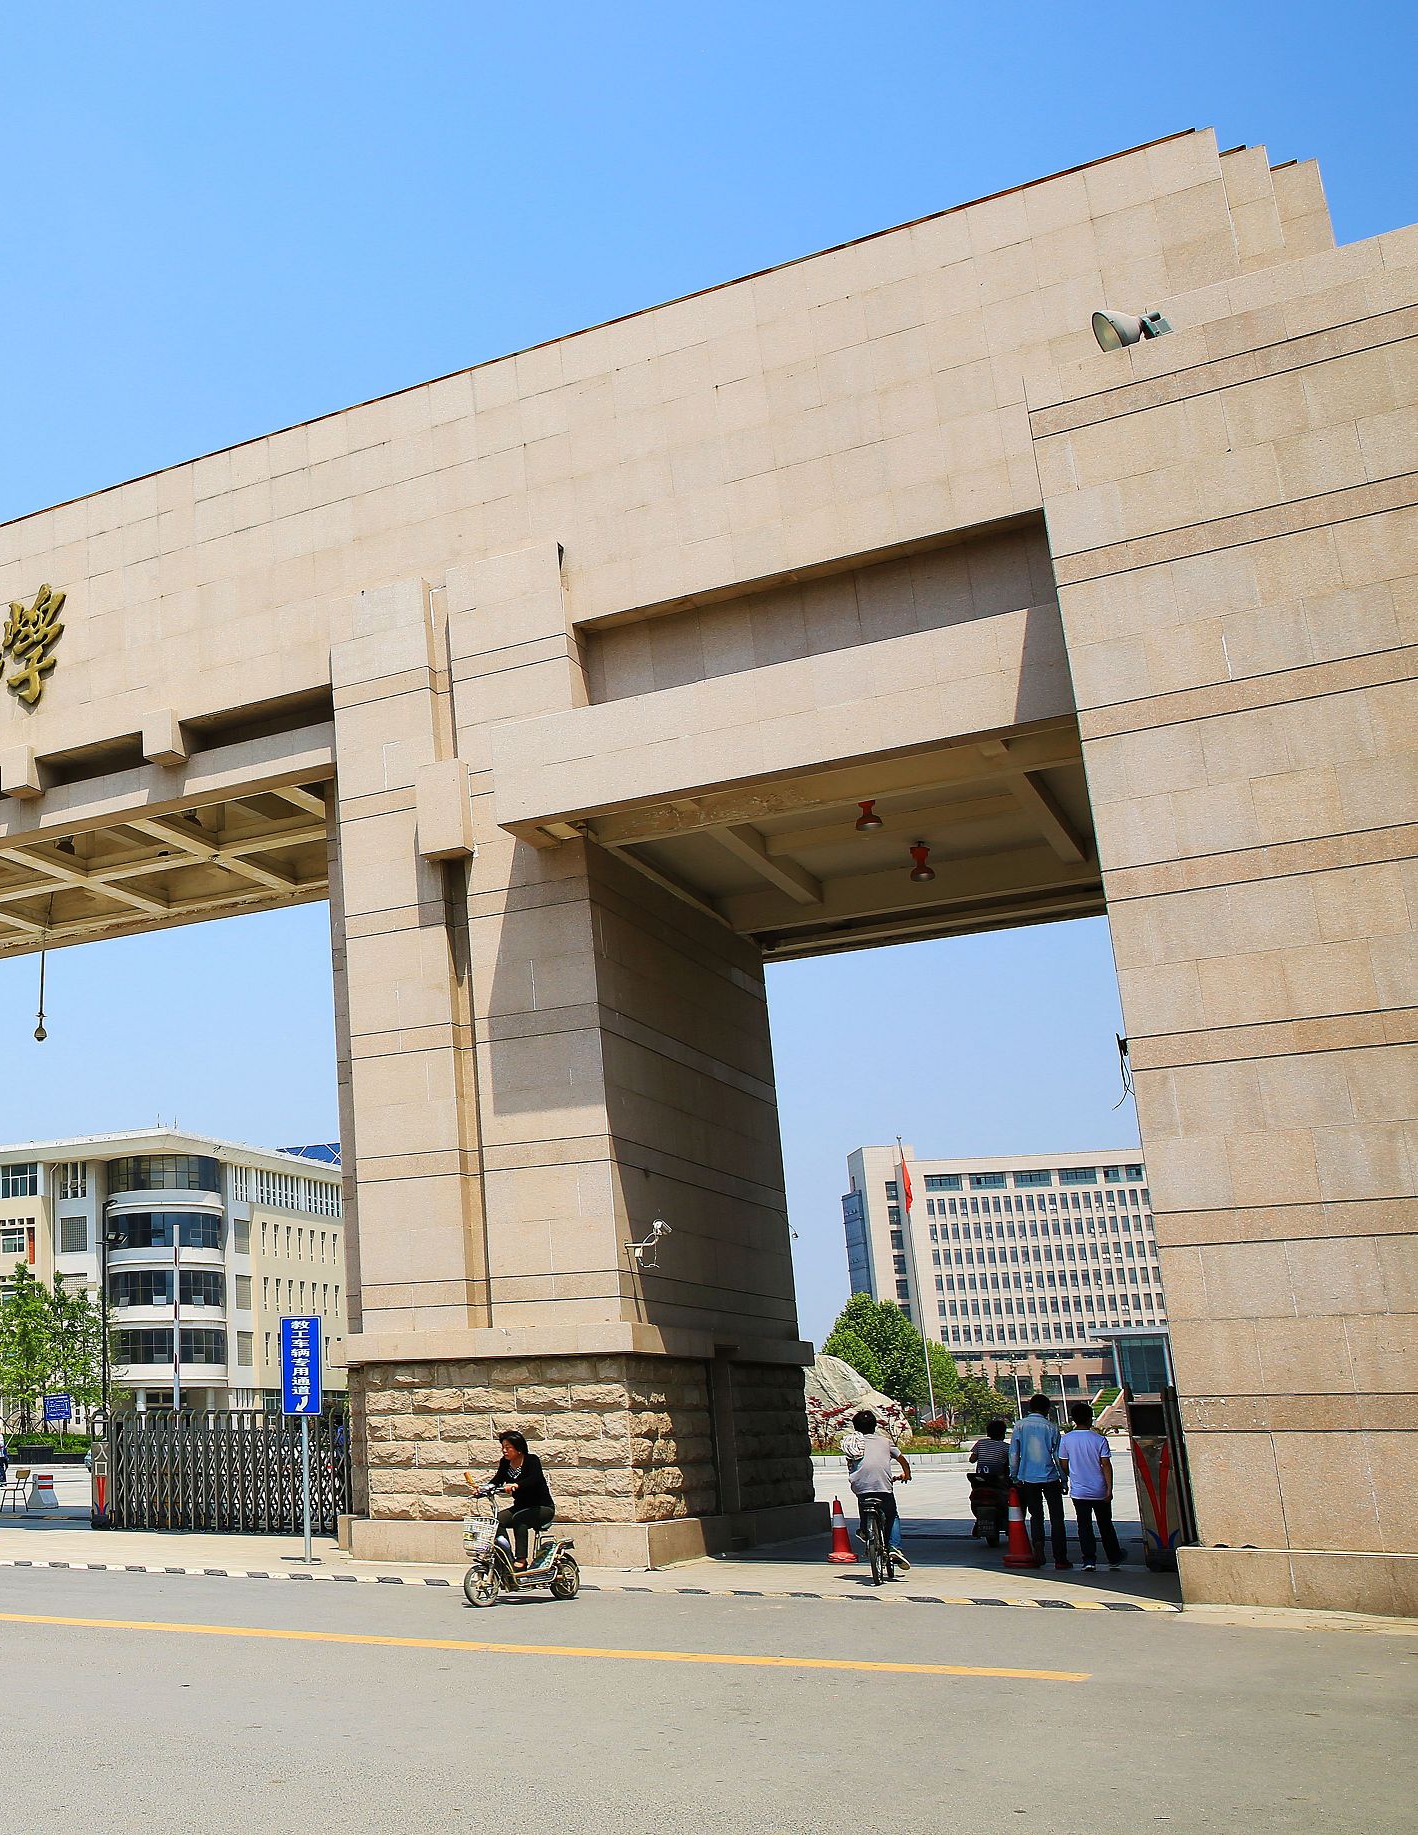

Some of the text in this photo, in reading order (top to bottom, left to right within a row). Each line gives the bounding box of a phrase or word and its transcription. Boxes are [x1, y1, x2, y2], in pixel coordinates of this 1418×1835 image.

[290, 1320, 311, 1395] 教工车辆专用通道
